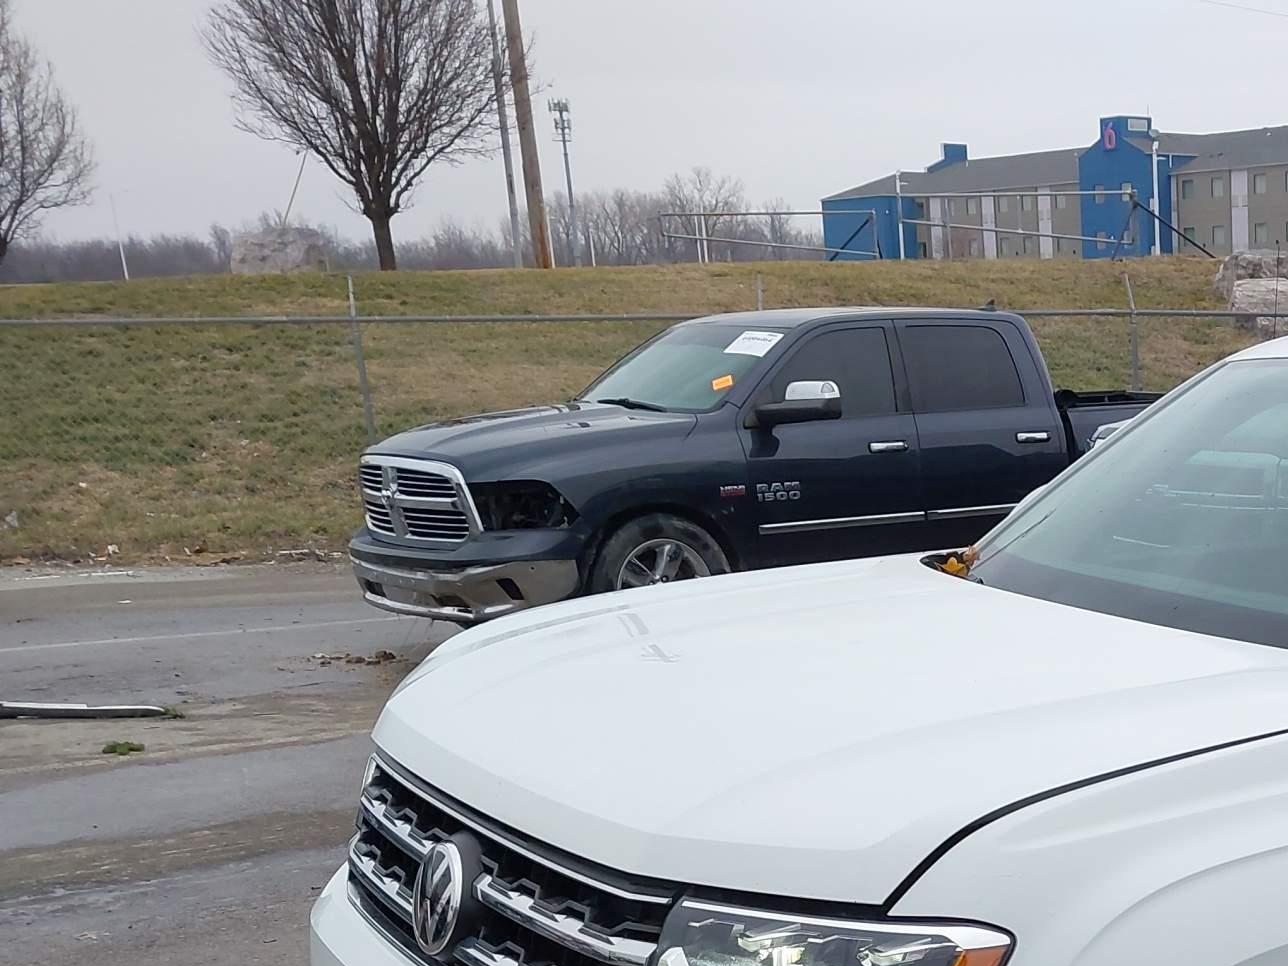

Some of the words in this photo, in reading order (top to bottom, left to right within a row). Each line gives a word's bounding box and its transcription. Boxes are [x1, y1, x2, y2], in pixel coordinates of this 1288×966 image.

[1104, 121, 1116, 150] 6
[756, 481, 800, 493] RAM
[757, 490, 800, 503] 1500
